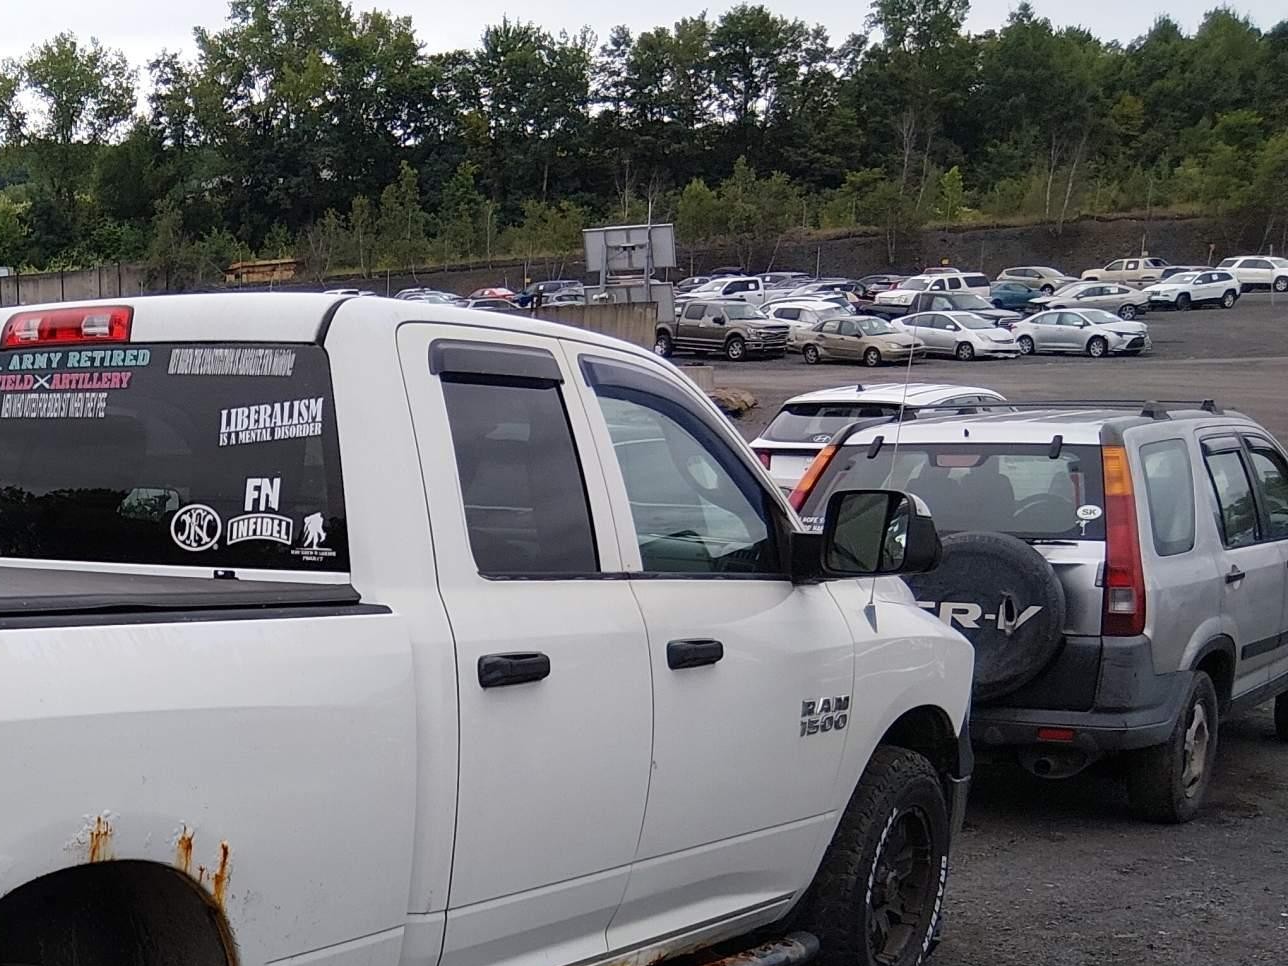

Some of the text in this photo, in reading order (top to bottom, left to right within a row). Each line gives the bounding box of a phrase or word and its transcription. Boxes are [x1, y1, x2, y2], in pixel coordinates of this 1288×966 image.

[9, 352, 63, 370] ARMY
[67, 349, 151, 368] RETIRED
[50, 372, 131, 390] ARTILLERY
[220, 397, 324, 434] LIBERALISM
[219, 422, 323, 447] IS A MENTAL DISORDER
[244, 477, 281, 512] FN
[232, 517, 288, 540] INFIDEL
[915, 601, 1043, 631] R-V
[801, 695, 850, 718] RAM
[799, 713, 848, 737] 1500
